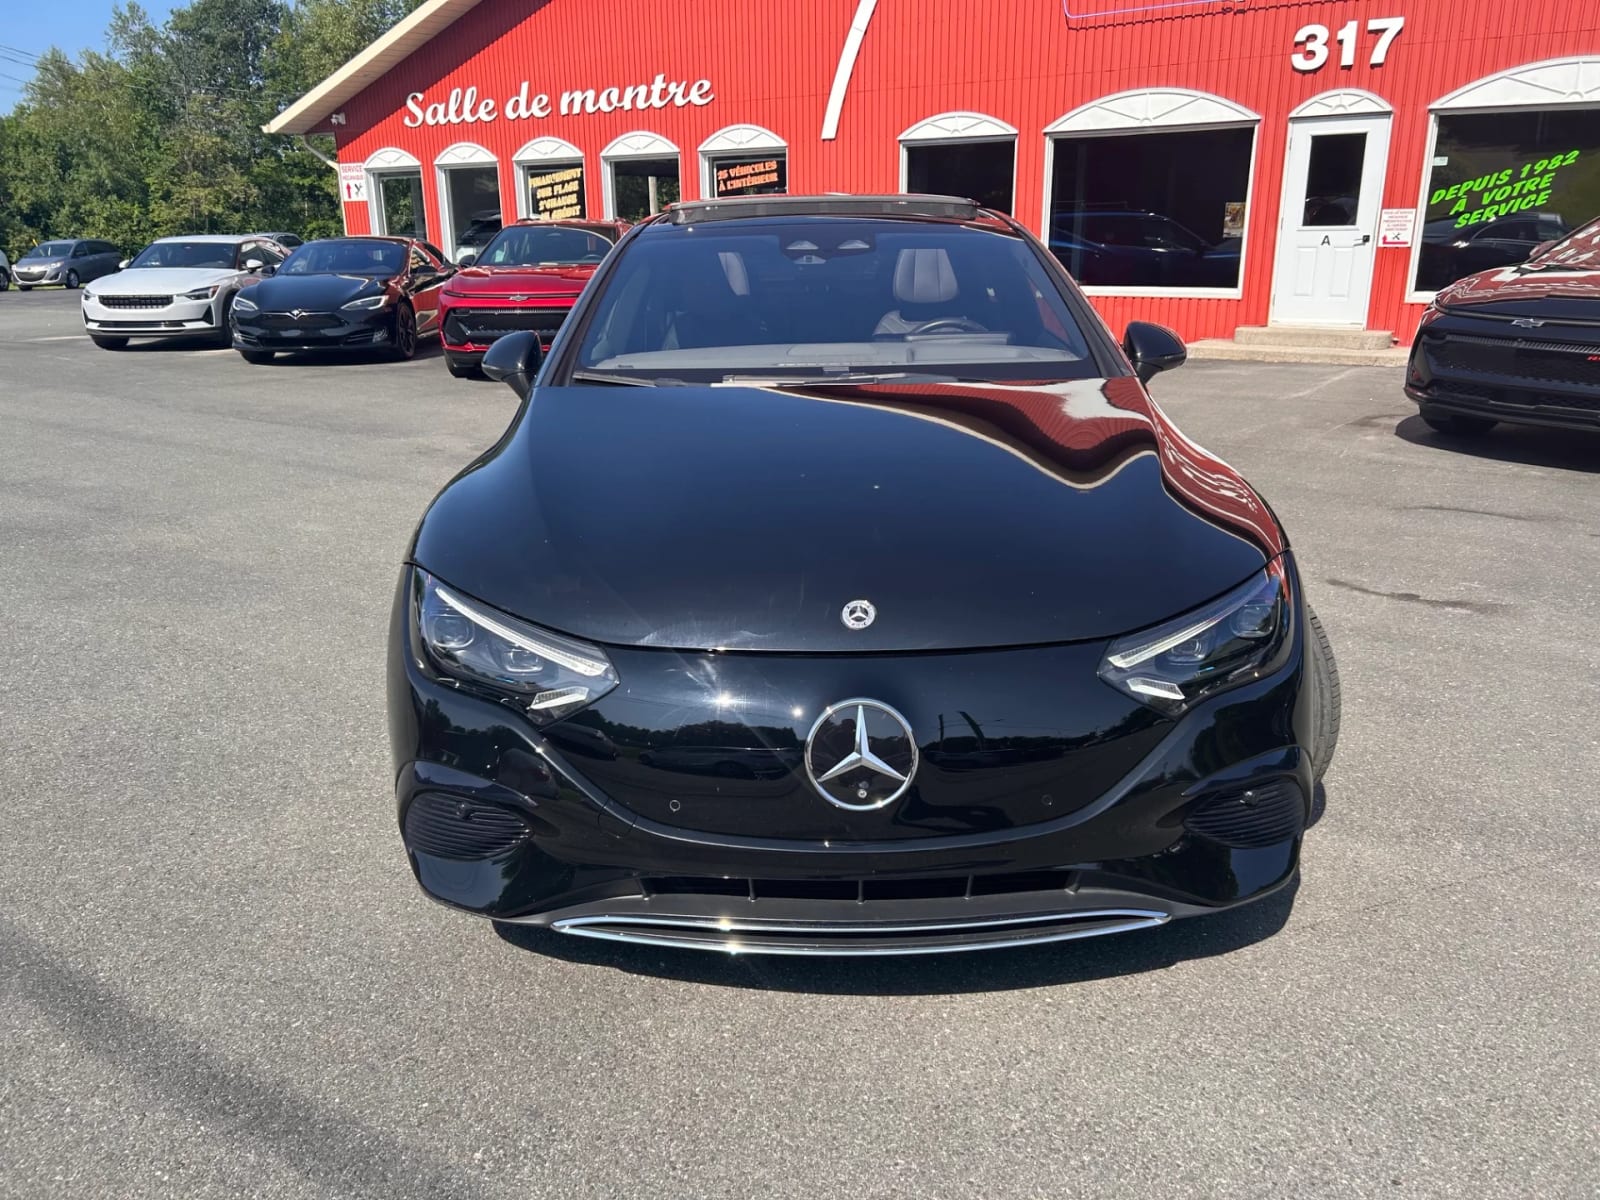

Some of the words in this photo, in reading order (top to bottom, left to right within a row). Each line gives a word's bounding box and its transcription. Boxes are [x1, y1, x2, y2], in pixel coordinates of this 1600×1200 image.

[1291, 15, 1405, 72] 317
[403, 86, 497, 129] Salle
[505, 81, 551, 120] de
[559, 74, 715, 116] montre
[729, 160, 778, 177] VÉHICULES
[1430, 169, 1513, 205] DEPUIS
[1520, 150, 1580, 178] 1982
[1449, 195, 1468, 215] À
[1481, 172, 1556, 205] VOTRE
[1454, 190, 1552, 228] SERVICE
[1320, 234, 1331, 246] A
